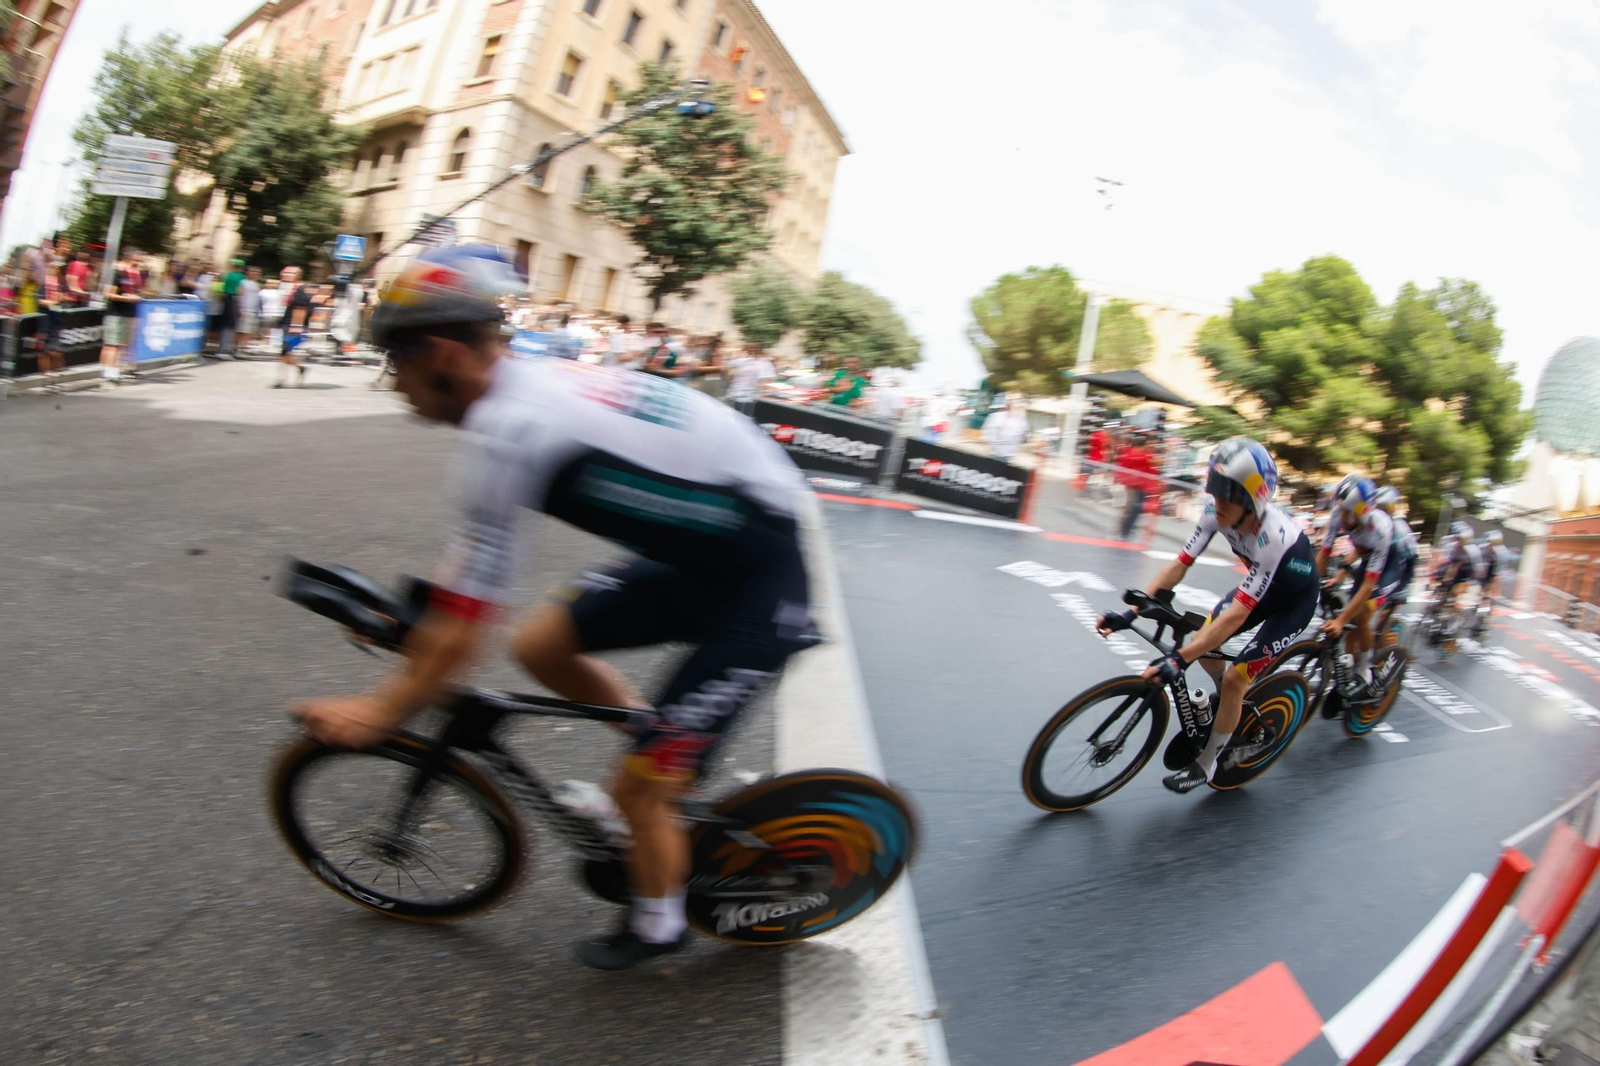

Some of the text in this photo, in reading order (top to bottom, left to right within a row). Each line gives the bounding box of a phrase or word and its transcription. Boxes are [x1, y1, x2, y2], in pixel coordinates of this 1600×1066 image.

[939, 463, 1024, 496] TISSOT
[1242, 561, 1261, 589] BOSS
[1255, 570, 1272, 598] BORA
[1173, 677, 1198, 738] S-WORKS
